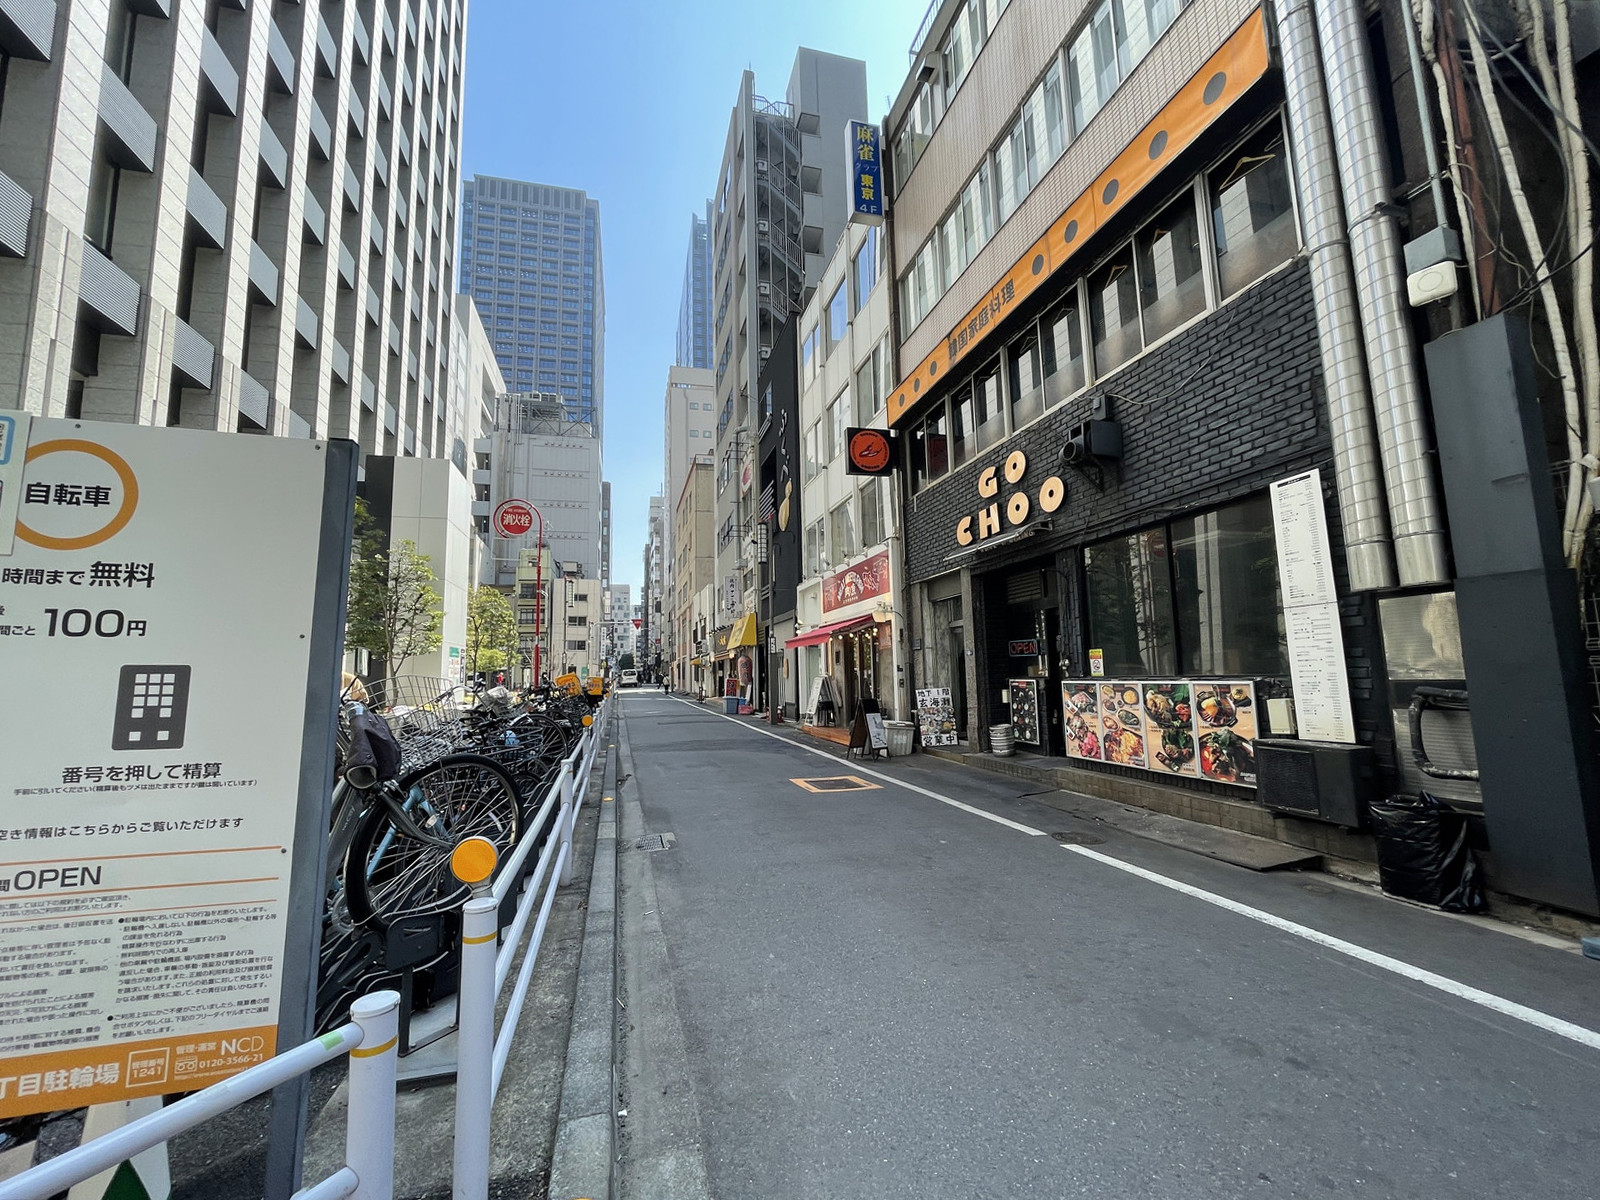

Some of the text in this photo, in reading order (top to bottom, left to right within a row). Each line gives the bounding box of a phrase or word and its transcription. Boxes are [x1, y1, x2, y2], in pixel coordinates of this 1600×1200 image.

[857, 125, 875, 161] 麻雀
[861, 174, 875, 201] 東京
[860, 204, 878, 214] 4F
[947, 279, 1016, 361] 韓国家庭料理
[978, 449, 1026, 499] GO
[25, 482, 112, 507] 自転車
[503, 513, 531, 527] 消火栓
[956, 476, 1065, 546] CHOO
[44, 607, 147, 638] 100円
[1010, 642, 1037, 654] OPEN
[923, 734, 954, 747] 営業中
[62, 762, 222, 784] 番号を押して精算
[221, 1036, 264, 1056] NCD
[133, 1066, 162, 1078] 1241
[199, 1053, 264, 1069] 0120-3566-21
